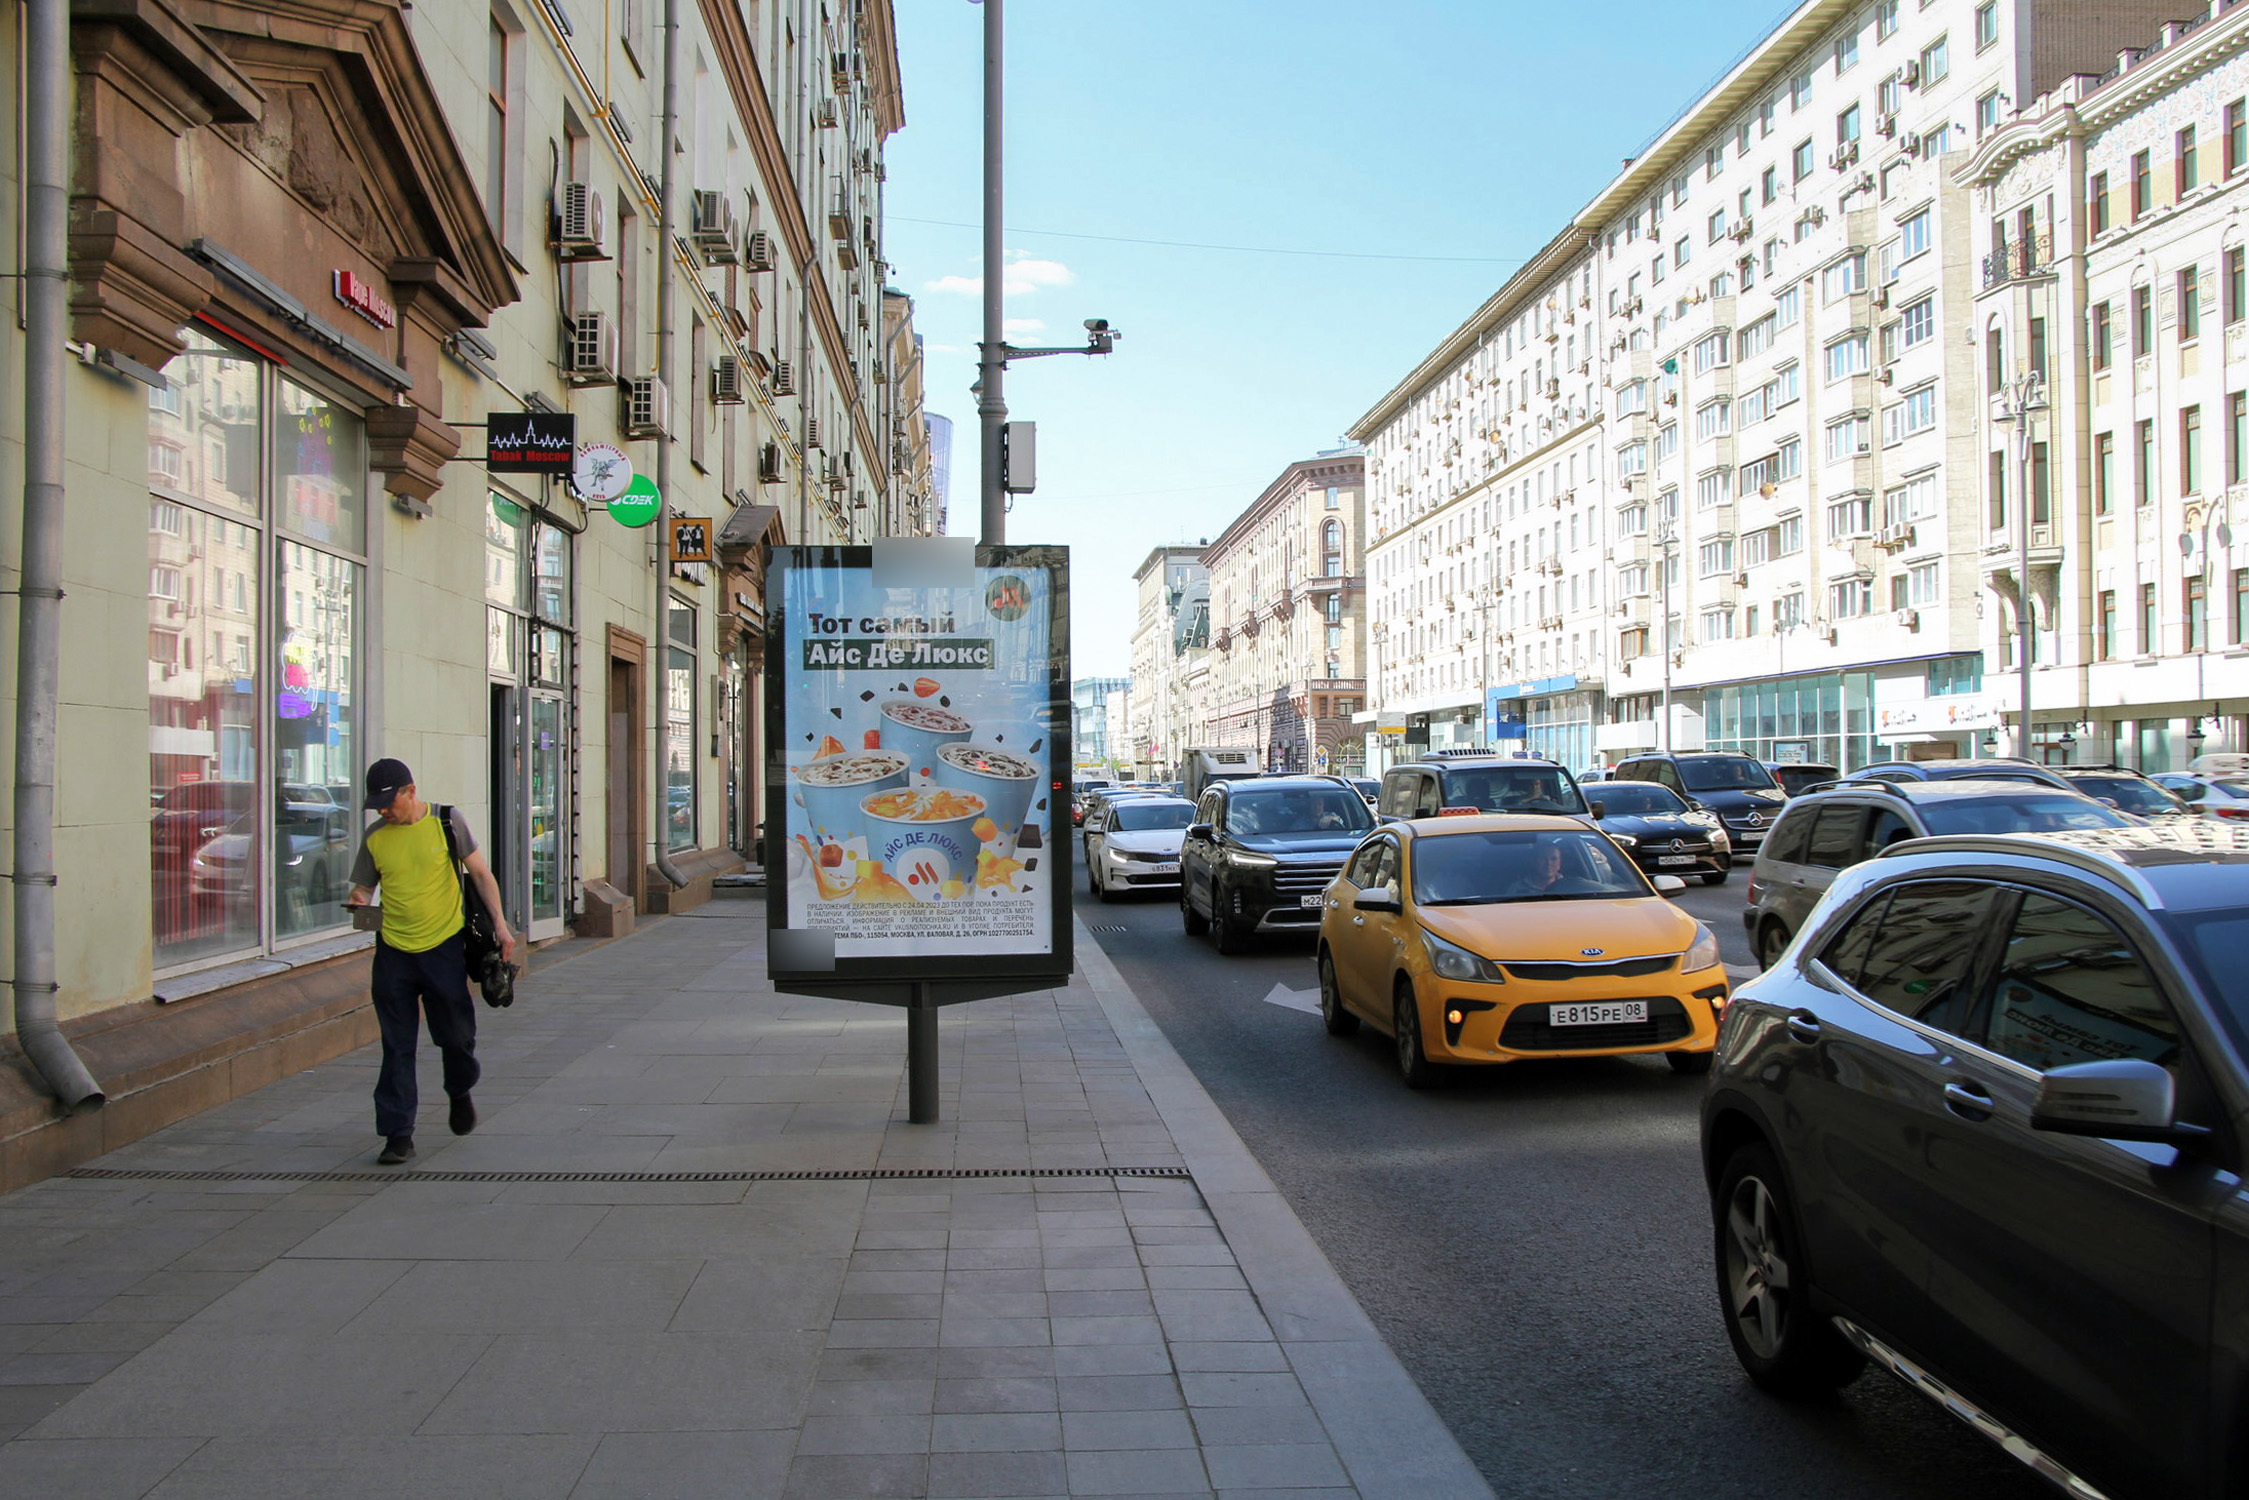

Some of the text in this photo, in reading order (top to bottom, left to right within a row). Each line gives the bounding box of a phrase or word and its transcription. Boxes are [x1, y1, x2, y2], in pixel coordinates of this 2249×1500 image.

[490, 450, 571, 462] Tabak Moscow
[622, 495, 655, 505] CDEK
[809, 611, 955, 634] Тот самый
[809, 642, 988, 668] Айс Де Люкс
[884, 832, 963, 863] АЙС ДЕ ЛЮКС
[852, 902, 901, 910] ДЕЙСТВИТЕЛЬНО
[941, 901, 950, 909] ДО
[975, 900, 991, 908] ПОКА
[992, 900, 1018, 908] ПРОДУКТ
[936, 908, 966, 916] ВНЕШНИЙ
[1582, 948, 1602, 956] KIA
